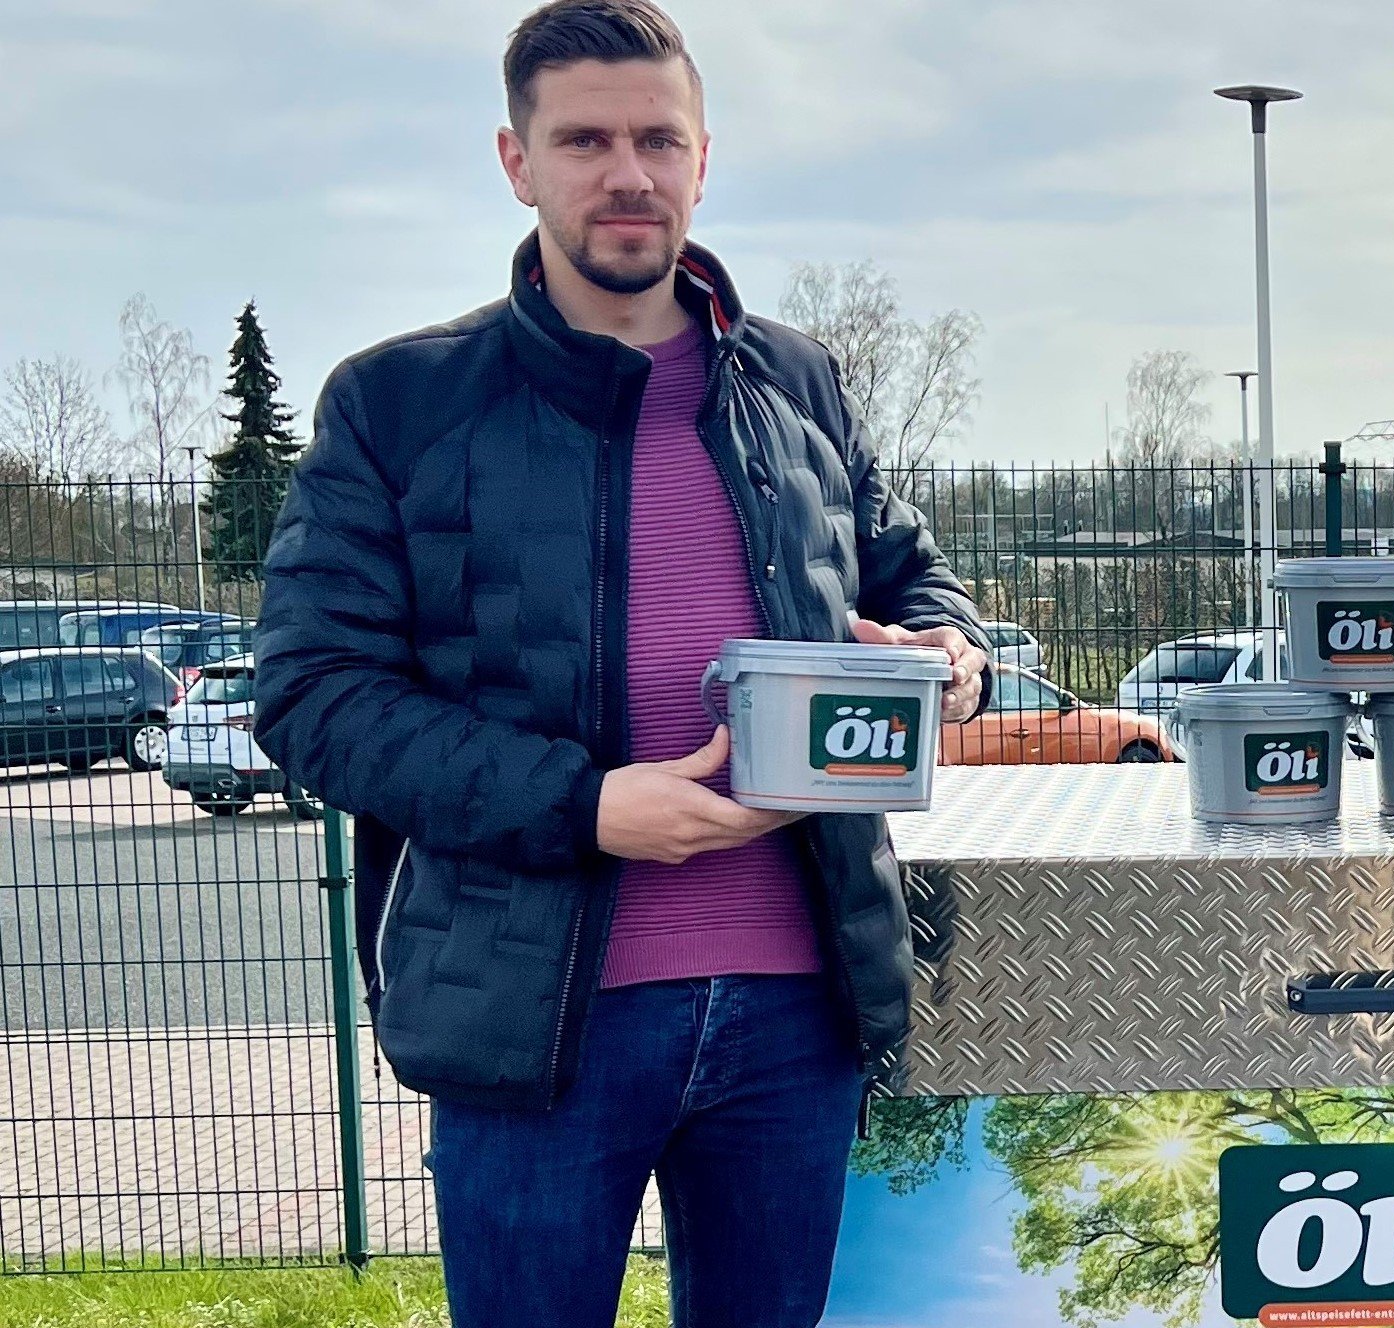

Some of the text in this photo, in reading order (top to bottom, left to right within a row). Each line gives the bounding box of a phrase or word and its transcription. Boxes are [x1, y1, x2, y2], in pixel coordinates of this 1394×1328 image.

[1327, 610, 1394, 651] Öli
[825, 706, 907, 759] Öli
[1256, 741, 1319, 783] Öli
